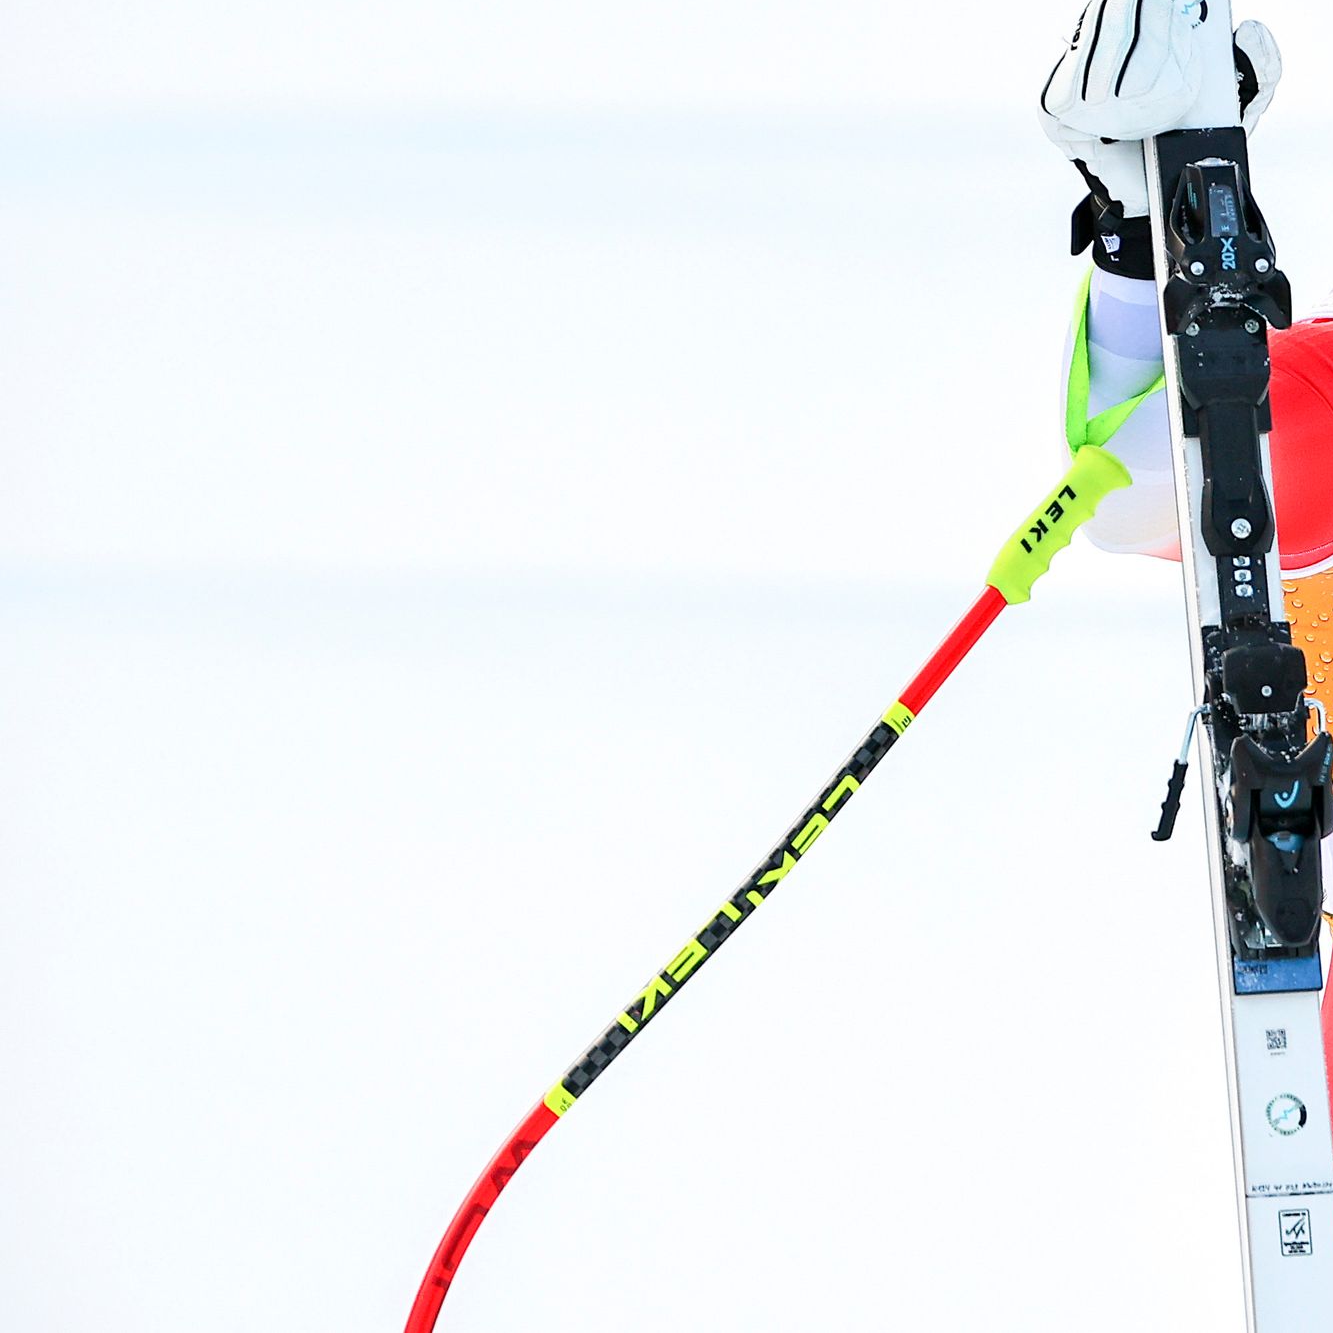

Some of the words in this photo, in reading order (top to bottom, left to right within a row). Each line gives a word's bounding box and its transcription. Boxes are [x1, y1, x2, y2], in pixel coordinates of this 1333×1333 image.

[1220, 237, 1236, 270] 20X
[1020, 484, 1077, 554] LEKI
[745, 774, 861, 907] LEKI
[616, 900, 743, 1034] LEKI
